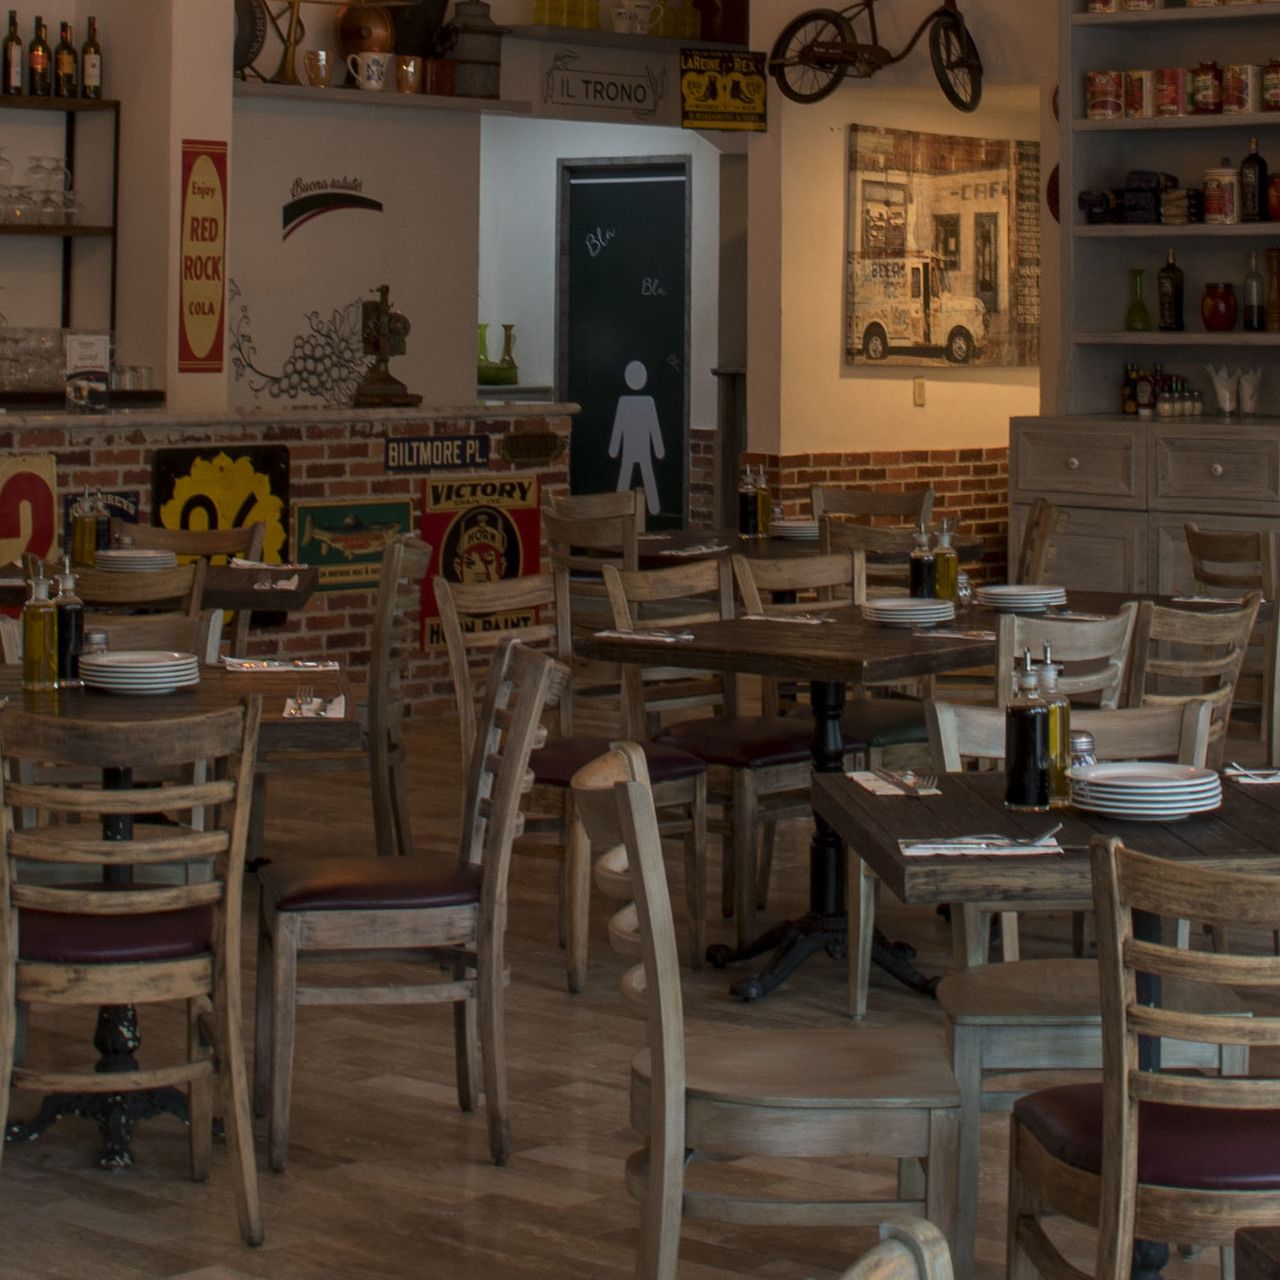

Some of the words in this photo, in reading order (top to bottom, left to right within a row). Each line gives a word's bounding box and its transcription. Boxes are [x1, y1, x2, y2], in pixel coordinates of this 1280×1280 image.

[560, 80, 577, 99] IL
[583, 82, 647, 104] TRONO
[191, 180, 216, 201] Enjoy
[190, 216, 218, 242] RED
[184, 255, 221, 282] ROCK
[188, 300, 215, 317] COLA
[387, 440, 462, 467] BILTMORE
[466, 439, 488, 464] PL.
[431, 481, 533, 507] VICTORY
[467, 527, 497, 543] HORN
